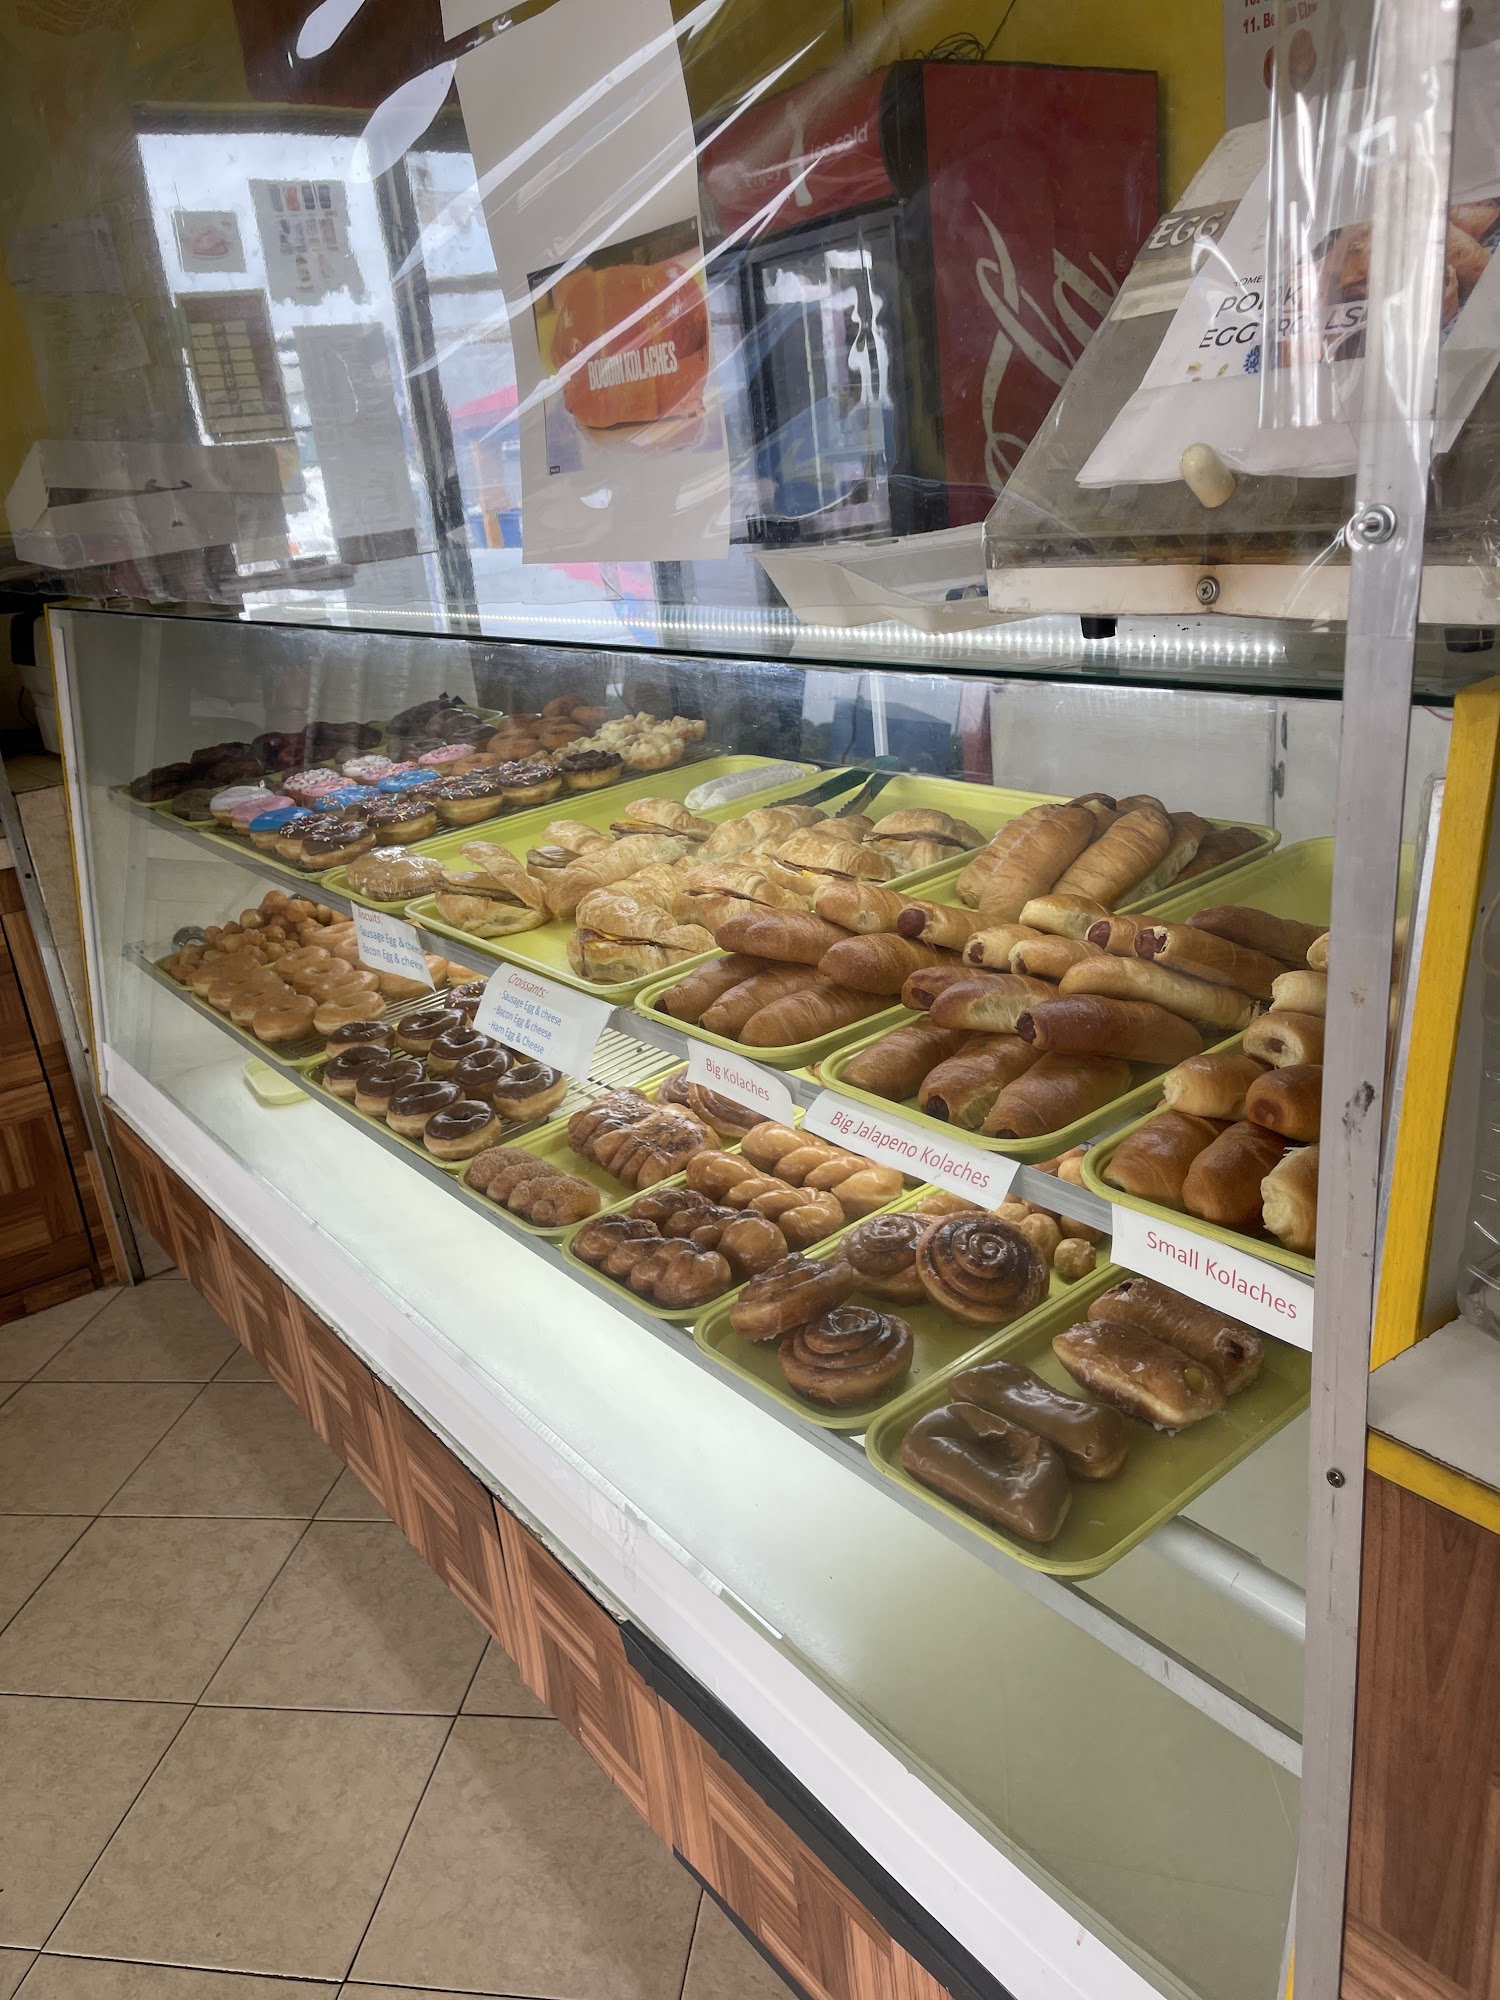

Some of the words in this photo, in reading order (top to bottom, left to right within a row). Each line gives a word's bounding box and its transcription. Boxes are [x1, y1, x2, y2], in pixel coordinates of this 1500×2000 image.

[1243, 16, 1261, 34] 11.
[1147, 211, 1226, 250] EGG
[1215, 286, 1302, 318] POK
[1198, 322, 1261, 348] EGG
[587, 353, 624, 391] BOUDIN
[624, 340, 679, 383] KOLACHES
[398, 937, 405, 948] &
[382, 949, 394, 964] Egg
[394, 953, 401, 964] &
[507, 973, 549, 998] Croissants:
[524, 1000, 535, 1015] Egg
[535, 1006, 541, 1016] &
[541, 1009, 562, 1026] cheese
[514, 1014, 524, 1028] Egg
[525, 1019, 531, 1029] &
[531, 1023, 552, 1040] cheese
[504, 1027, 515, 1042] Egg
[515, 1033, 521, 1043] &
[522, 1036, 545, 1054] Cheese
[706, 1058, 721, 1080] Big
[723, 1067, 770, 1101] Kolaches
[830, 1111, 855, 1135] Big
[853, 1121, 918, 1158] Jalapeno
[919, 1146, 991, 1188] Kolaches
[1146, 1231, 1199, 1270] Small
[1205, 1258, 1297, 1319] Kolaches
